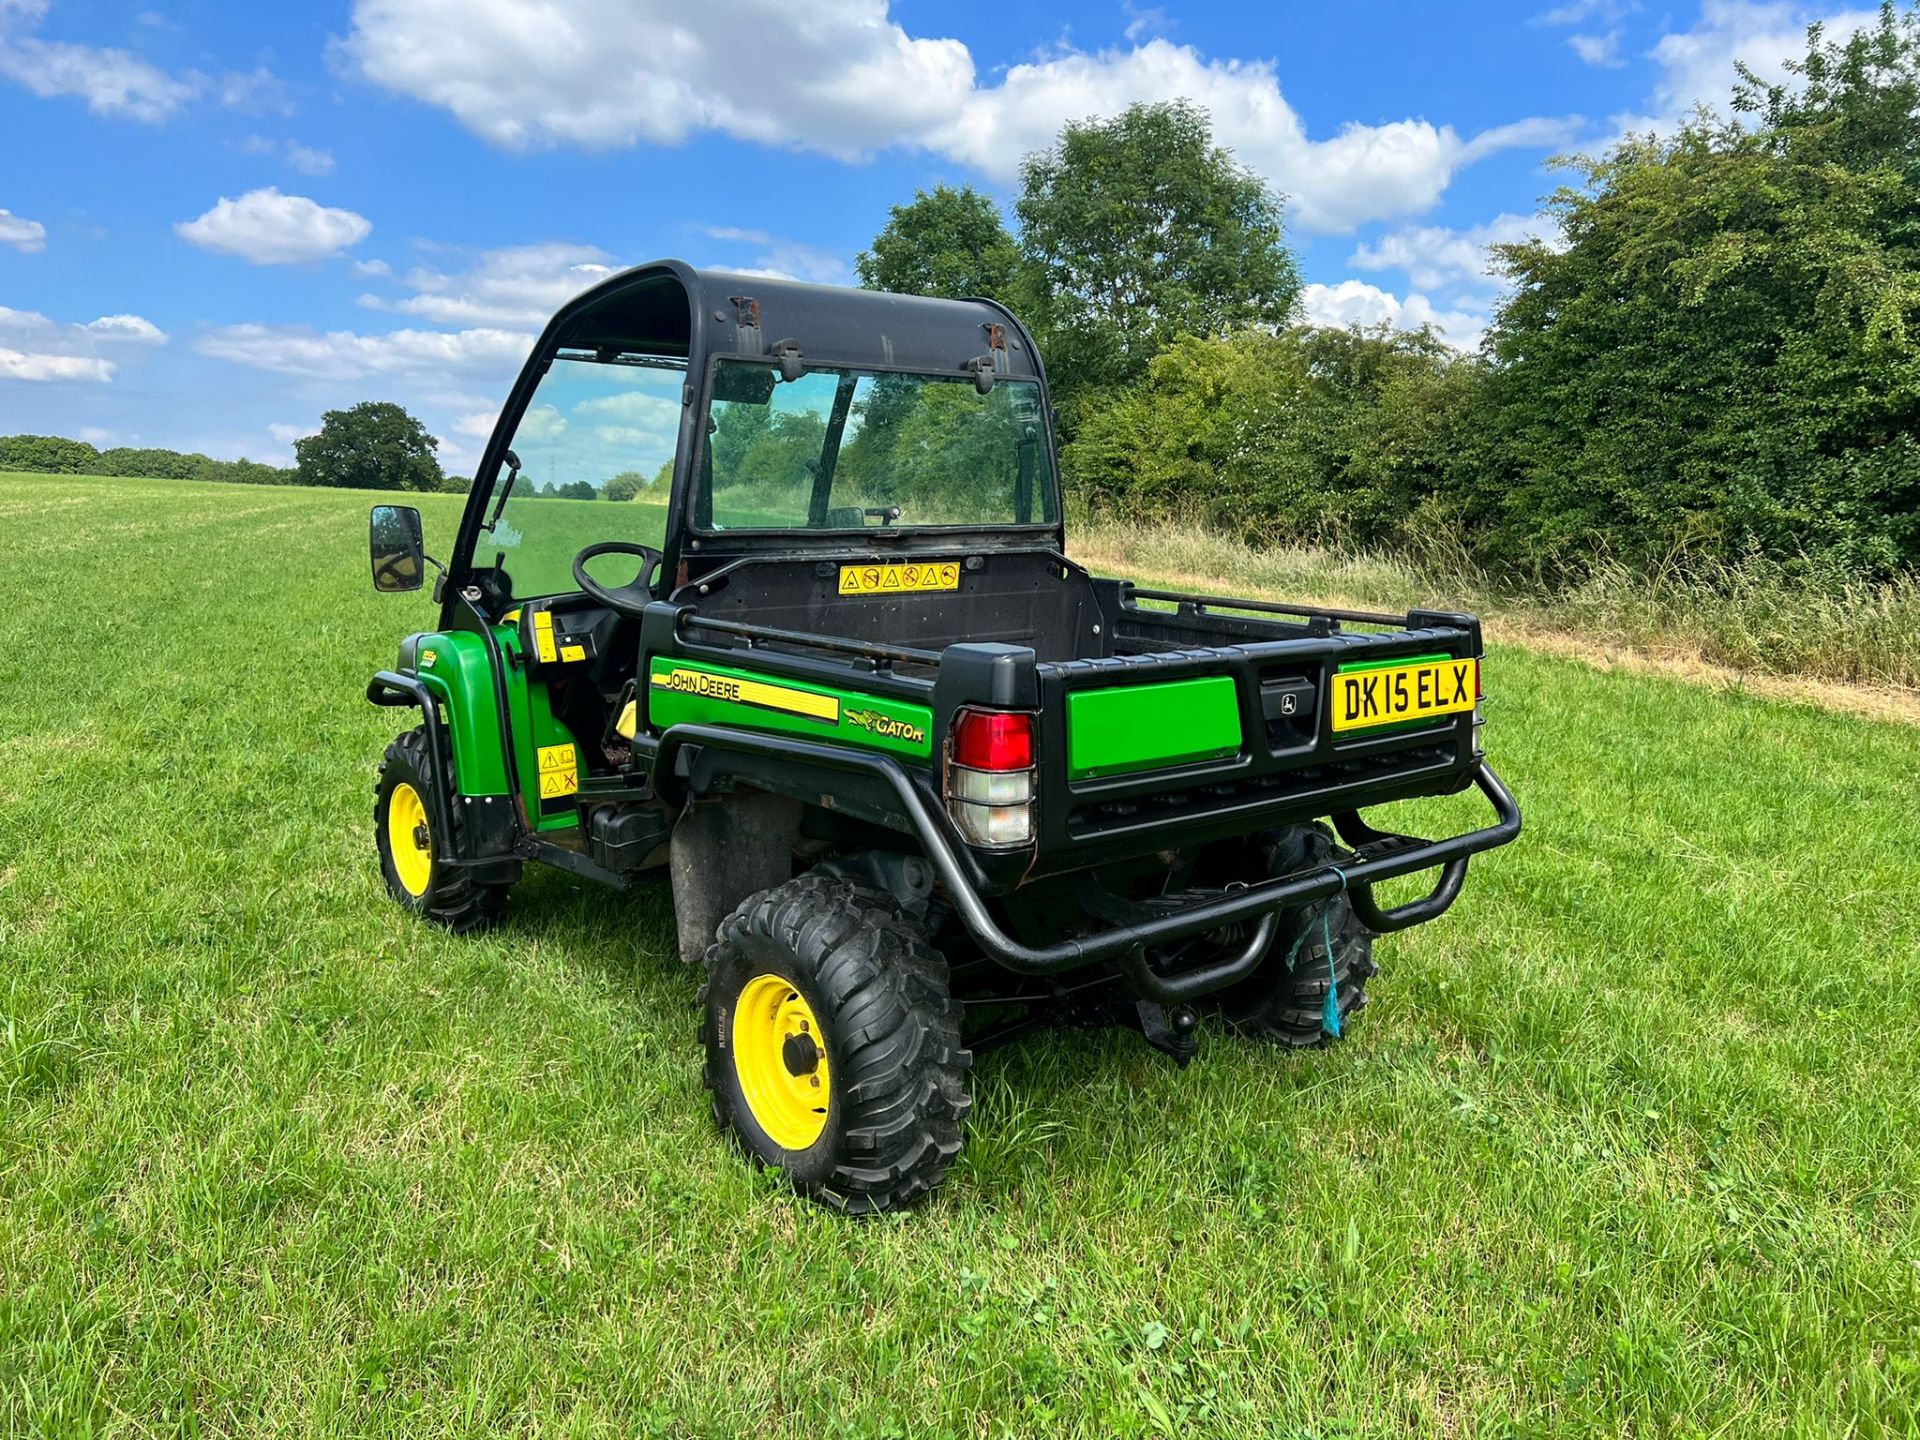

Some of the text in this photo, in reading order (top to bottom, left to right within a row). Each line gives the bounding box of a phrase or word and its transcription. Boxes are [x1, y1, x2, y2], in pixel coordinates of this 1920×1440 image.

[666, 673, 740, 698] JOHN DEERE
[1345, 664, 1467, 720] DK15 ELX
[876, 716, 924, 741] GATOR
